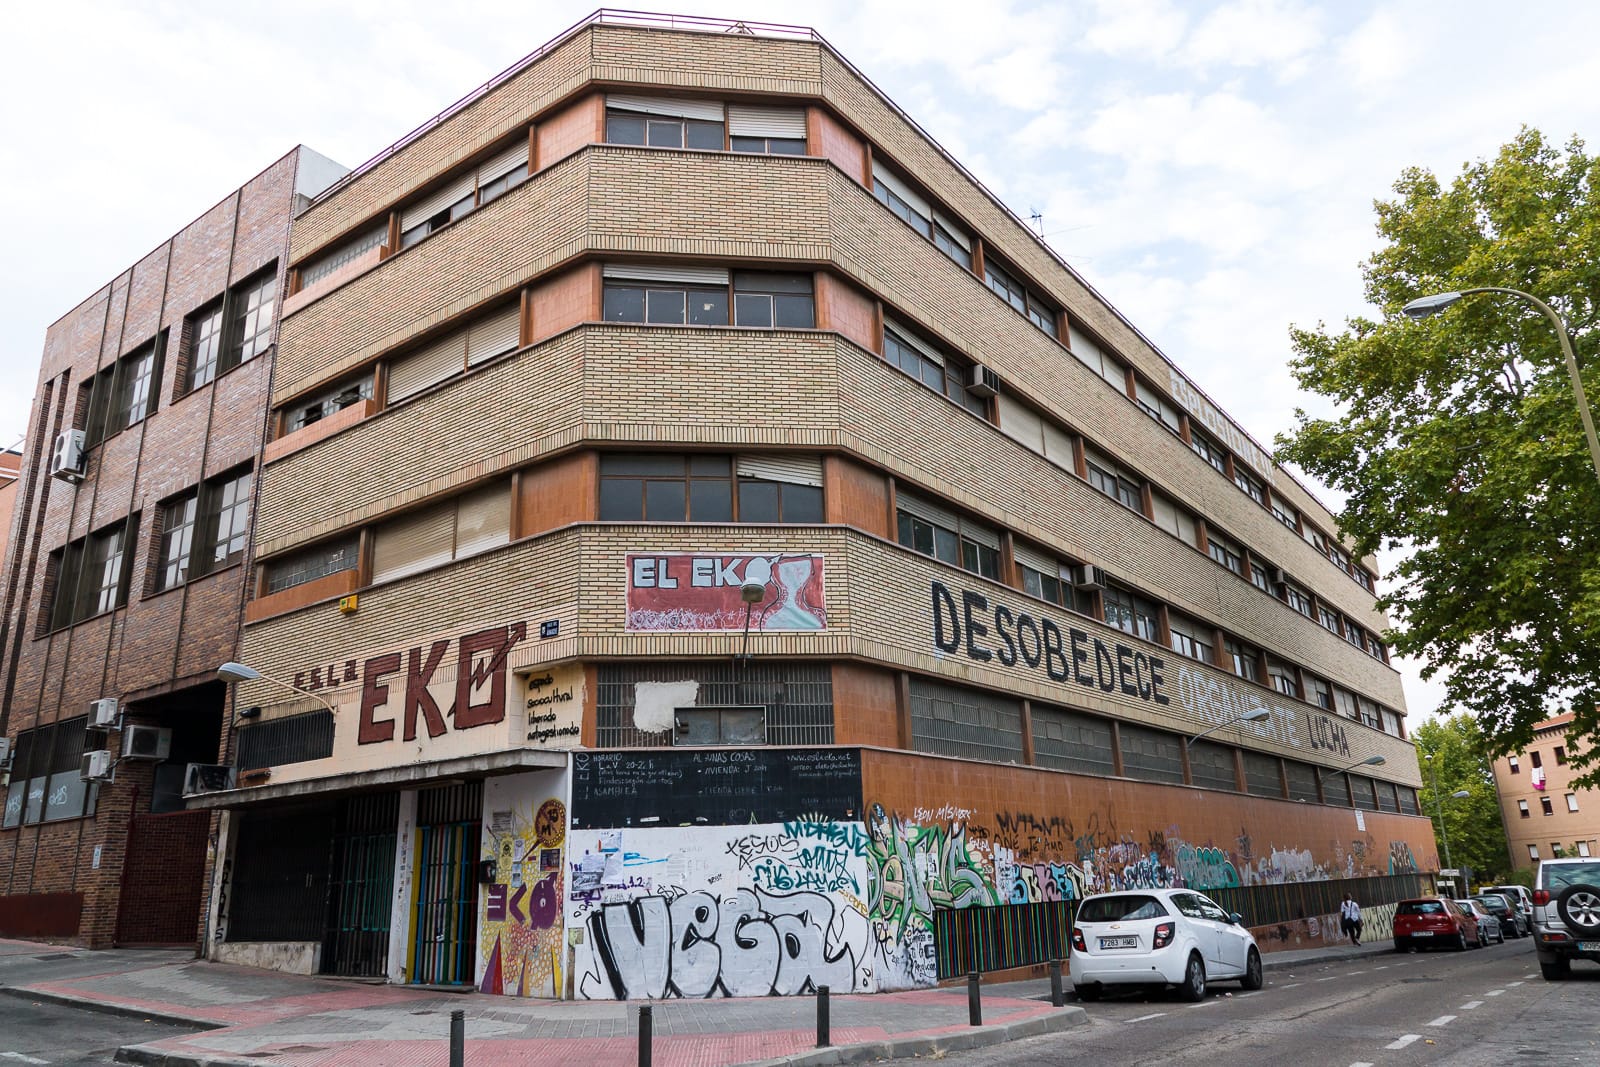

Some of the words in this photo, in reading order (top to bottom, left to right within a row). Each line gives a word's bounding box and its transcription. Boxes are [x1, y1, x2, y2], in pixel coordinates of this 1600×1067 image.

[633, 557, 679, 589] EL
[931, 580, 1170, 706] DESOBEDECE
[1306, 711, 1352, 758] LUCHA
[730, 752, 756, 762] COSAS
